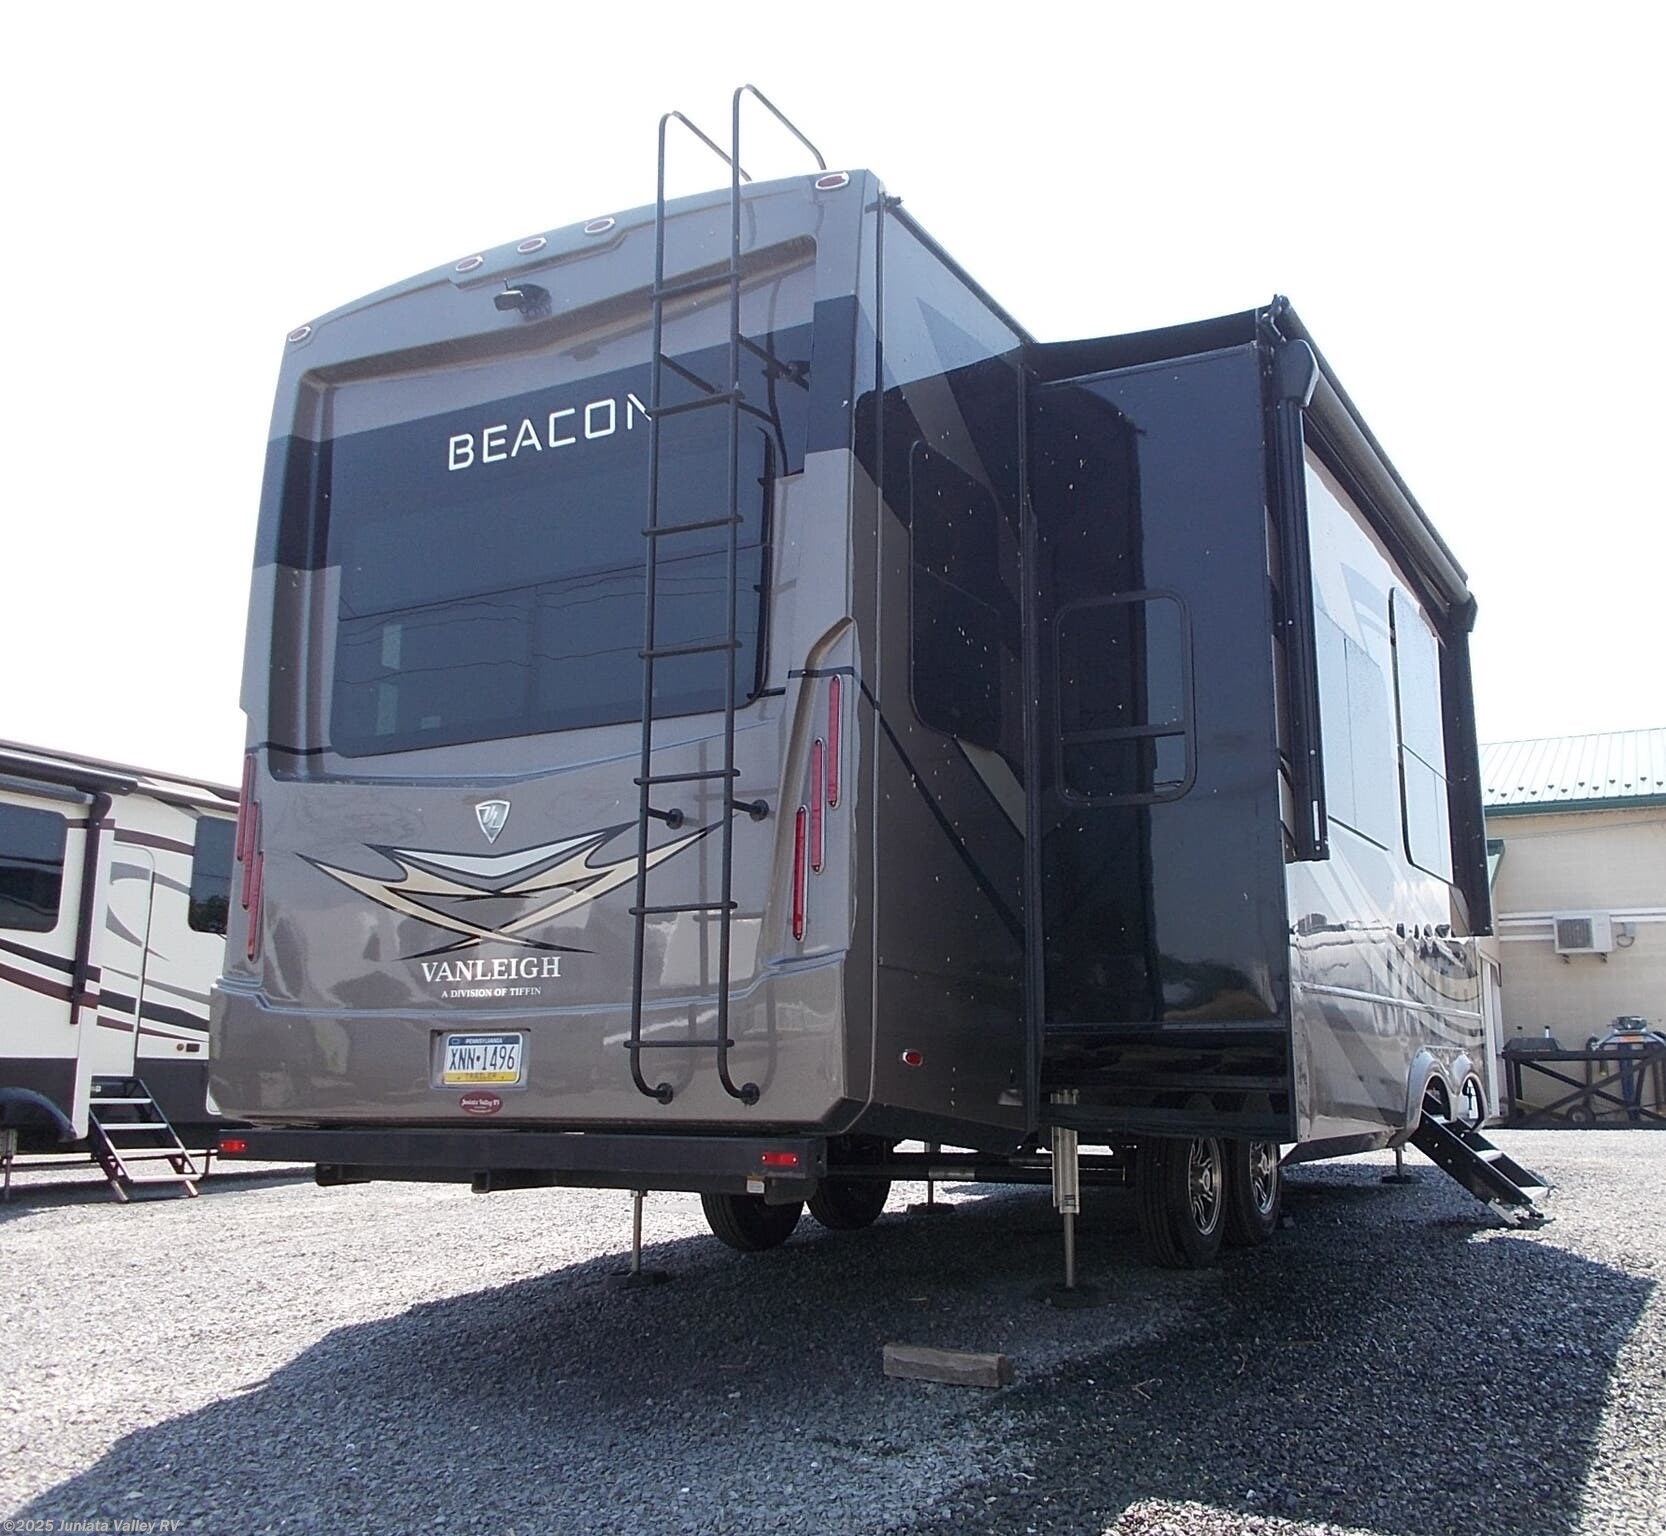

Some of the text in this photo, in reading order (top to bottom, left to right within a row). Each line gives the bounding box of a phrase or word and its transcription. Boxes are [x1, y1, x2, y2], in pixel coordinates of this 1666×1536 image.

[448, 393, 652, 471] BEACON
[421, 956, 561, 982] VANLEIGH
[441, 986, 541, 998] A DIVISION OF TIFFIN
